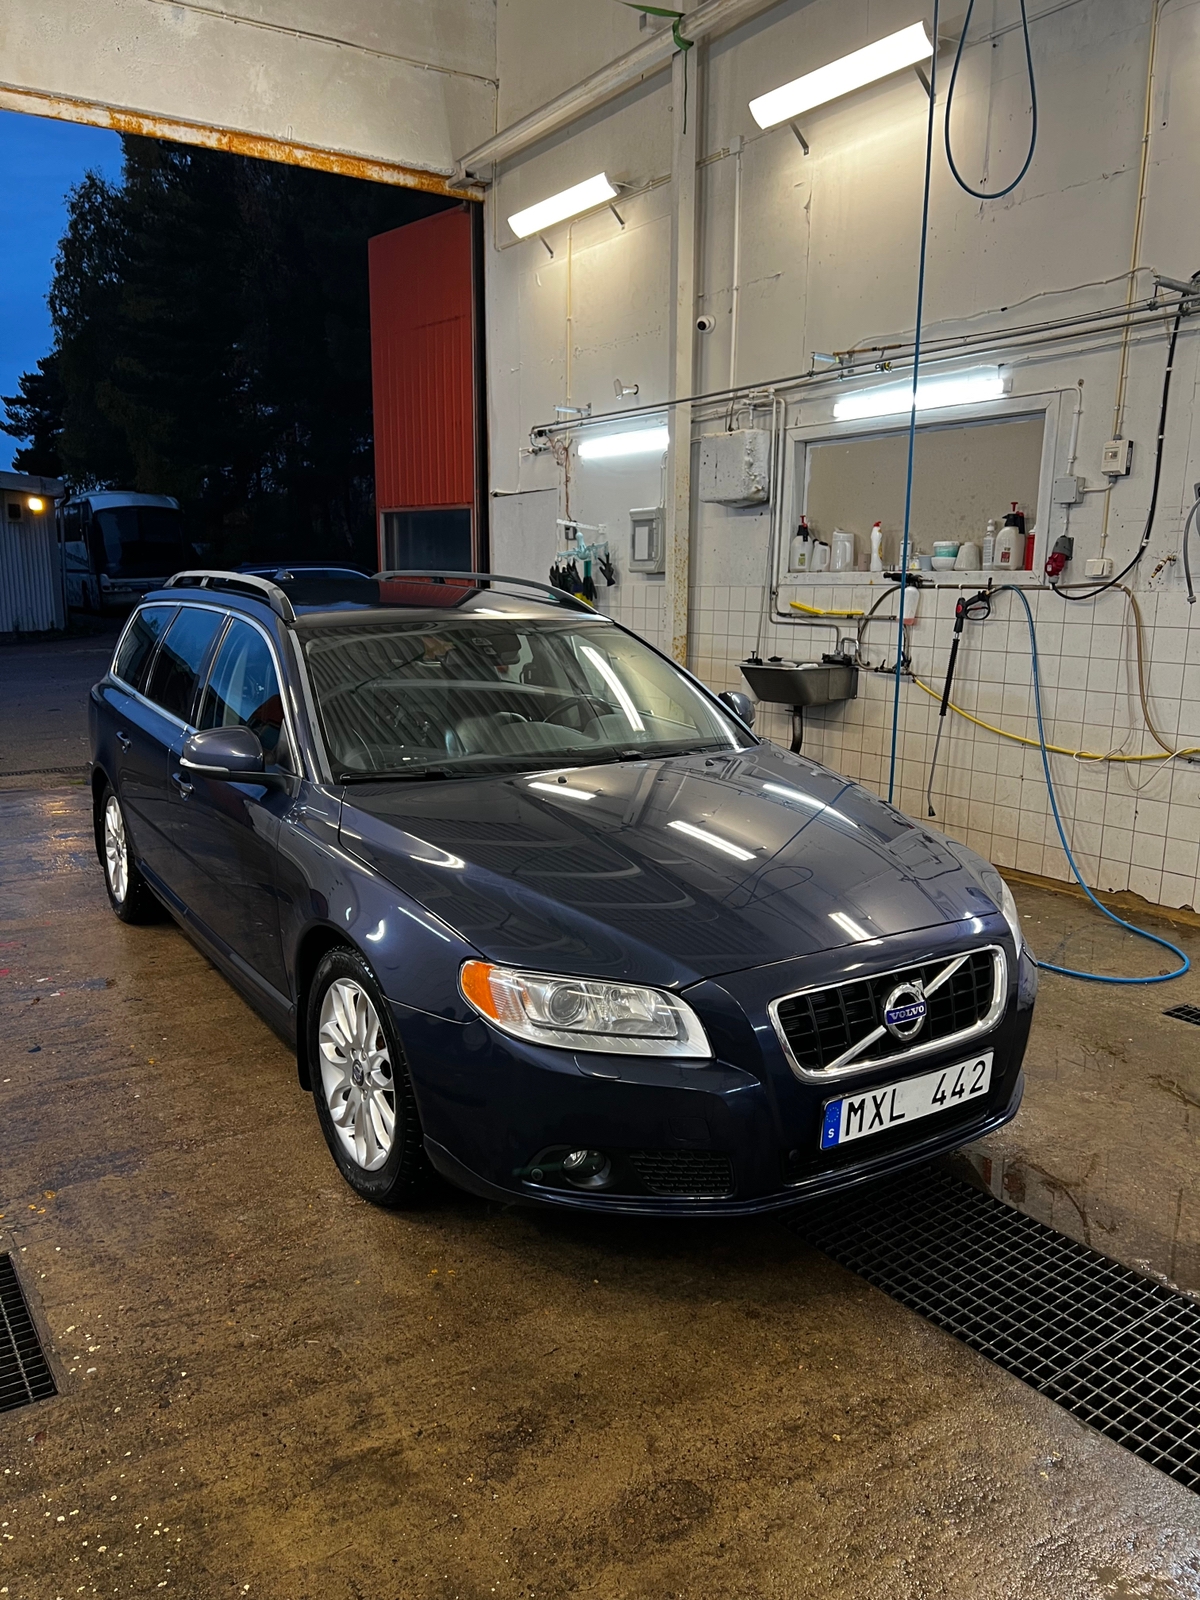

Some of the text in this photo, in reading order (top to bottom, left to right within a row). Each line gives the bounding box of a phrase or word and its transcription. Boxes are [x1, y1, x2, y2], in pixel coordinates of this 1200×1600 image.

[889, 1005, 925, 1021] VOLVO
[845, 1059, 986, 1137] MXL 442
[827, 1128, 836, 1139] S
